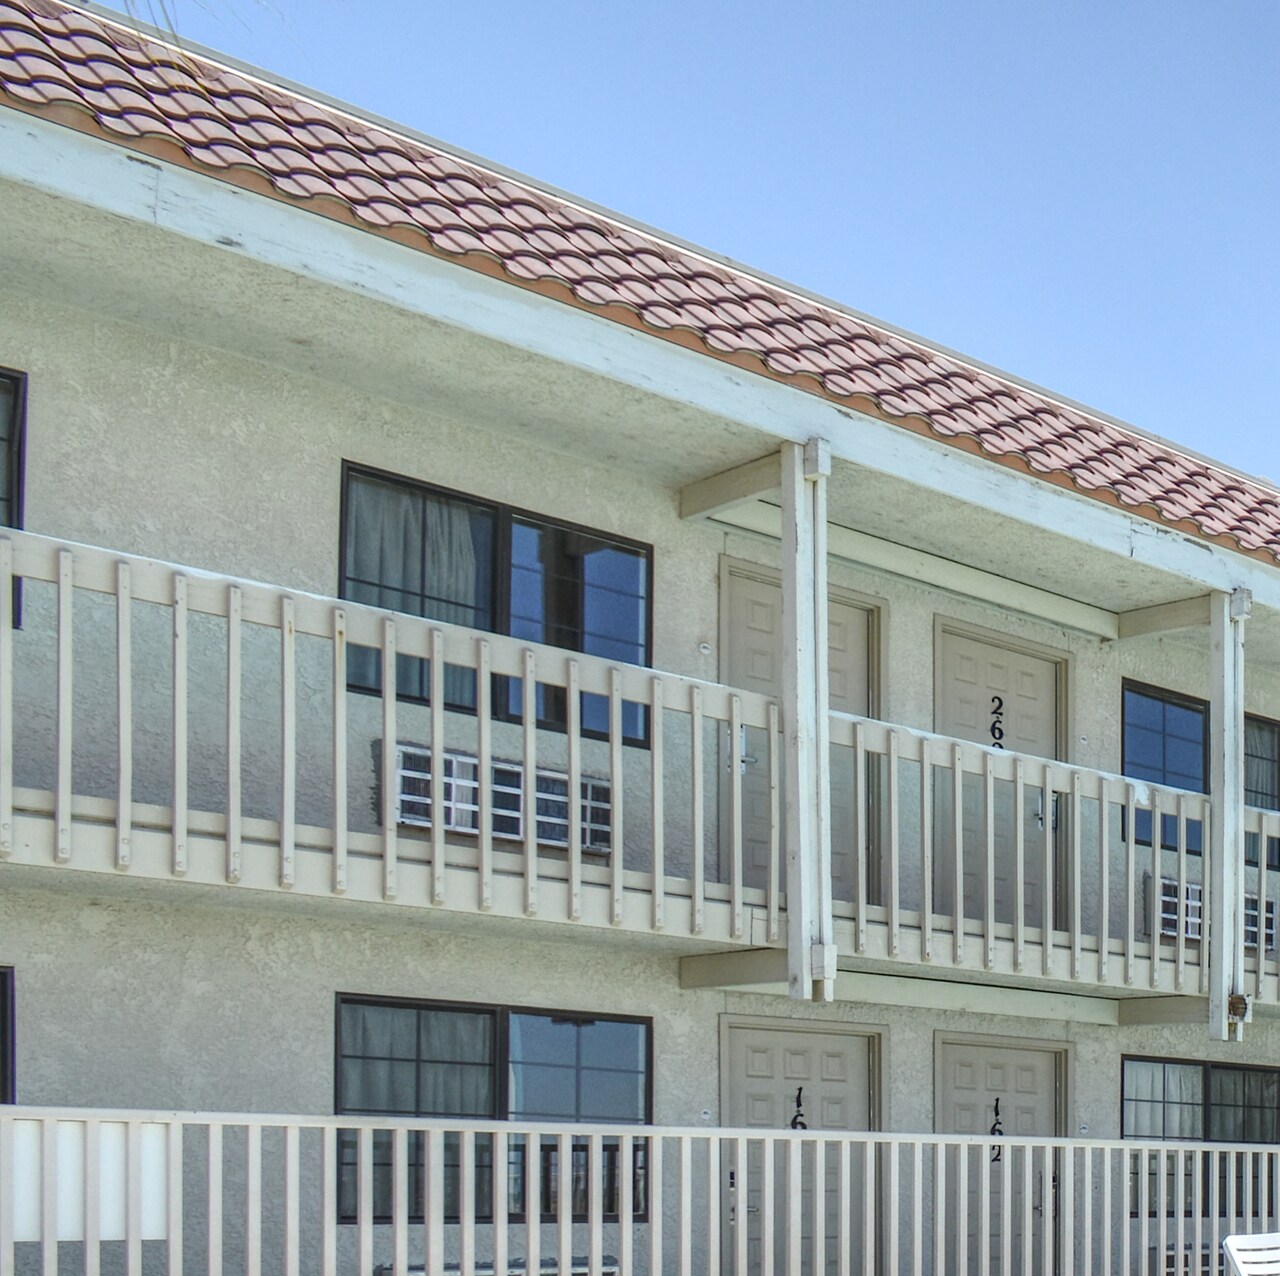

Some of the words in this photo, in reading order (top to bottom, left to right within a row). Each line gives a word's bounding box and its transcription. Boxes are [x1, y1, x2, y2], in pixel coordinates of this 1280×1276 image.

[990, 695, 1004, 750] 26
[790, 1086, 808, 1131] 16
[990, 1096, 1004, 1163] 162
